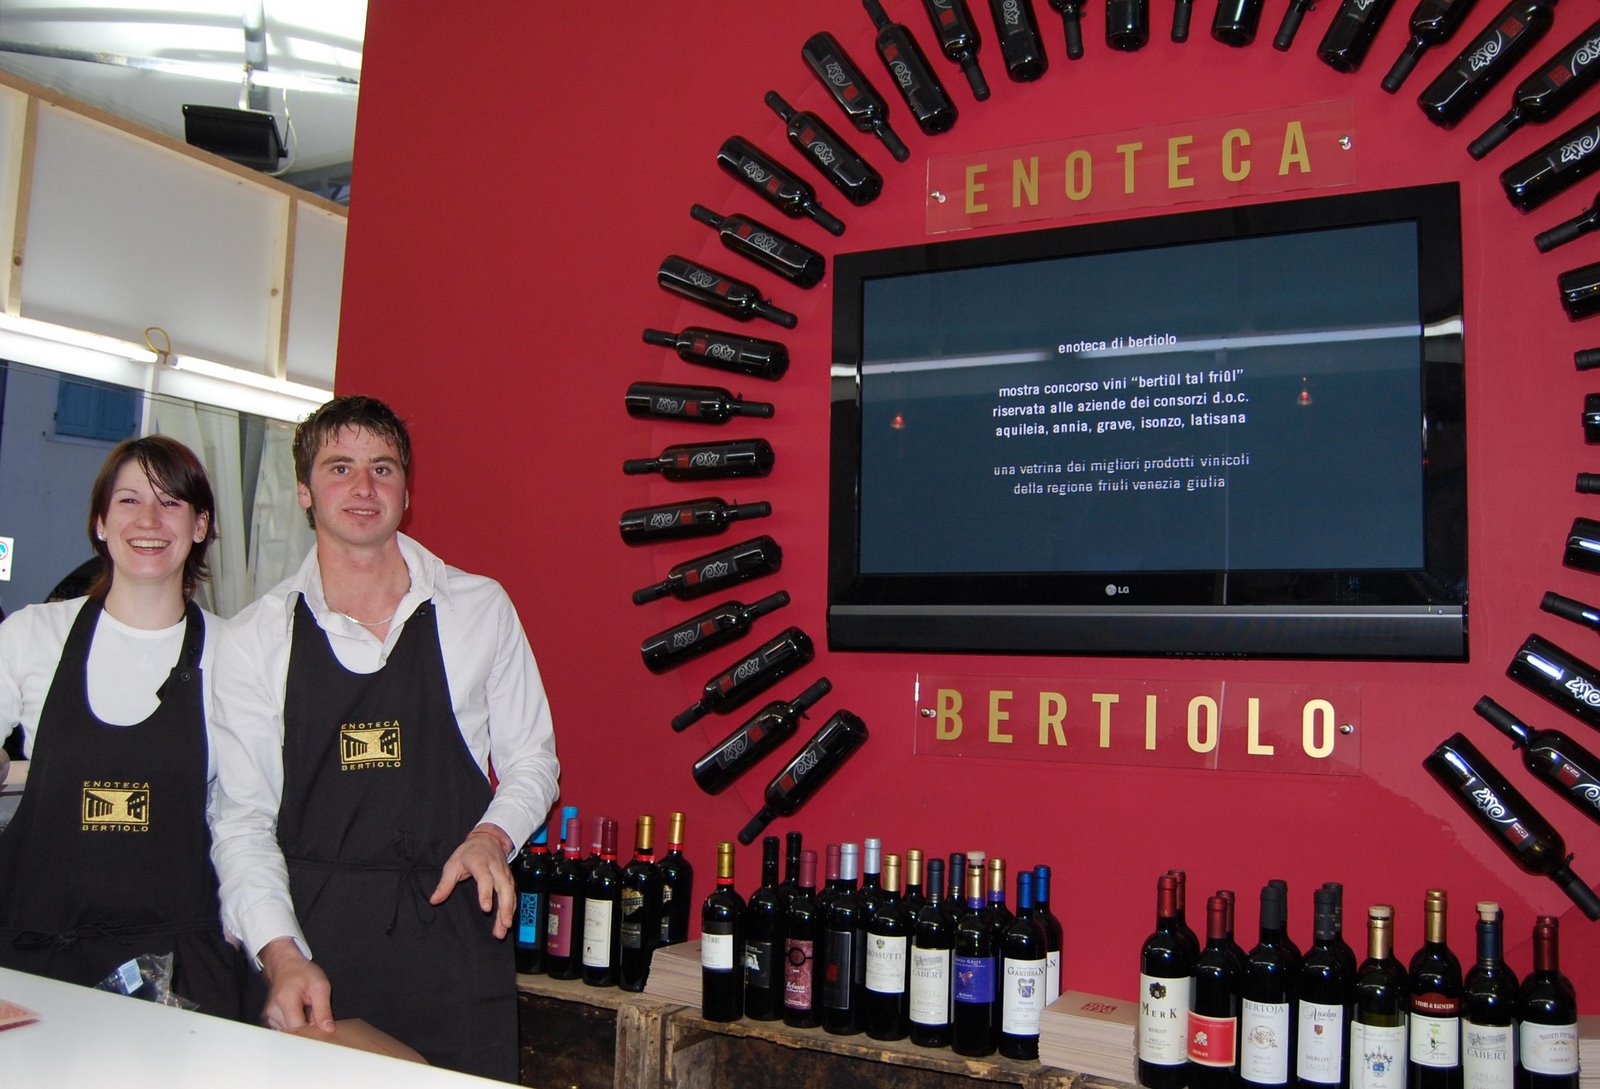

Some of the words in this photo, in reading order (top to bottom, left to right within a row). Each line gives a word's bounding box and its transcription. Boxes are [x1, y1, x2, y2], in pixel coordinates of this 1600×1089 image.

[965, 121, 1311, 214] ENOTECA
[1058, 340, 1106, 354] enoteca
[1111, 336, 1123, 349] di
[1128, 333, 1177, 348] bertiolo
[999, 383, 1040, 397] mostra
[1044, 380, 1099, 396] concorso
[1103, 377, 1127, 390] vini
[1185, 371, 1204, 384] tal
[993, 403, 1046, 417] riservata
[1050, 401, 1074, 414] alle
[1077, 398, 1126, 412] aziende
[1130, 396, 1150, 409] dei
[1153, 393, 1207, 408] consorzi
[1213, 391, 1249, 404] d.o.c.
[995, 422, 1049, 439] aquileia,
[1053, 420, 1092, 434] annia,
[1096, 419, 1136, 434] grave,
[1141, 416, 1185, 430] isonzo,
[1190, 412, 1246, 426] latisana
[993, 465, 1016, 476] una
[1020, 460, 1062, 474] vetrina
[1066, 459, 1086, 473] dei
[1091, 458, 1140, 474] migliori
[1144, 455, 1195, 472] prodotti
[1200, 453, 1250, 467] vinicoli
[1013, 481, 1043, 495] della
[1047, 482, 1093, 496] regione
[1098, 479, 1128, 492] friuli
[1132, 478, 1180, 490] venezia
[1186, 476, 1225, 492] giulia
[1118, 586, 1130, 594] LG
[341, 720, 400, 730] ENOTECA
[936, 688, 1336, 759] BERTIOLO
[341, 760, 401, 771] BERTIOLO
[83, 780, 150, 789] ENOTECA
[82, 824, 149, 832] BERTIOLO
[1142, 1002, 1178, 1019] MERK
[1467, 1048, 1508, 1061] CABERT
